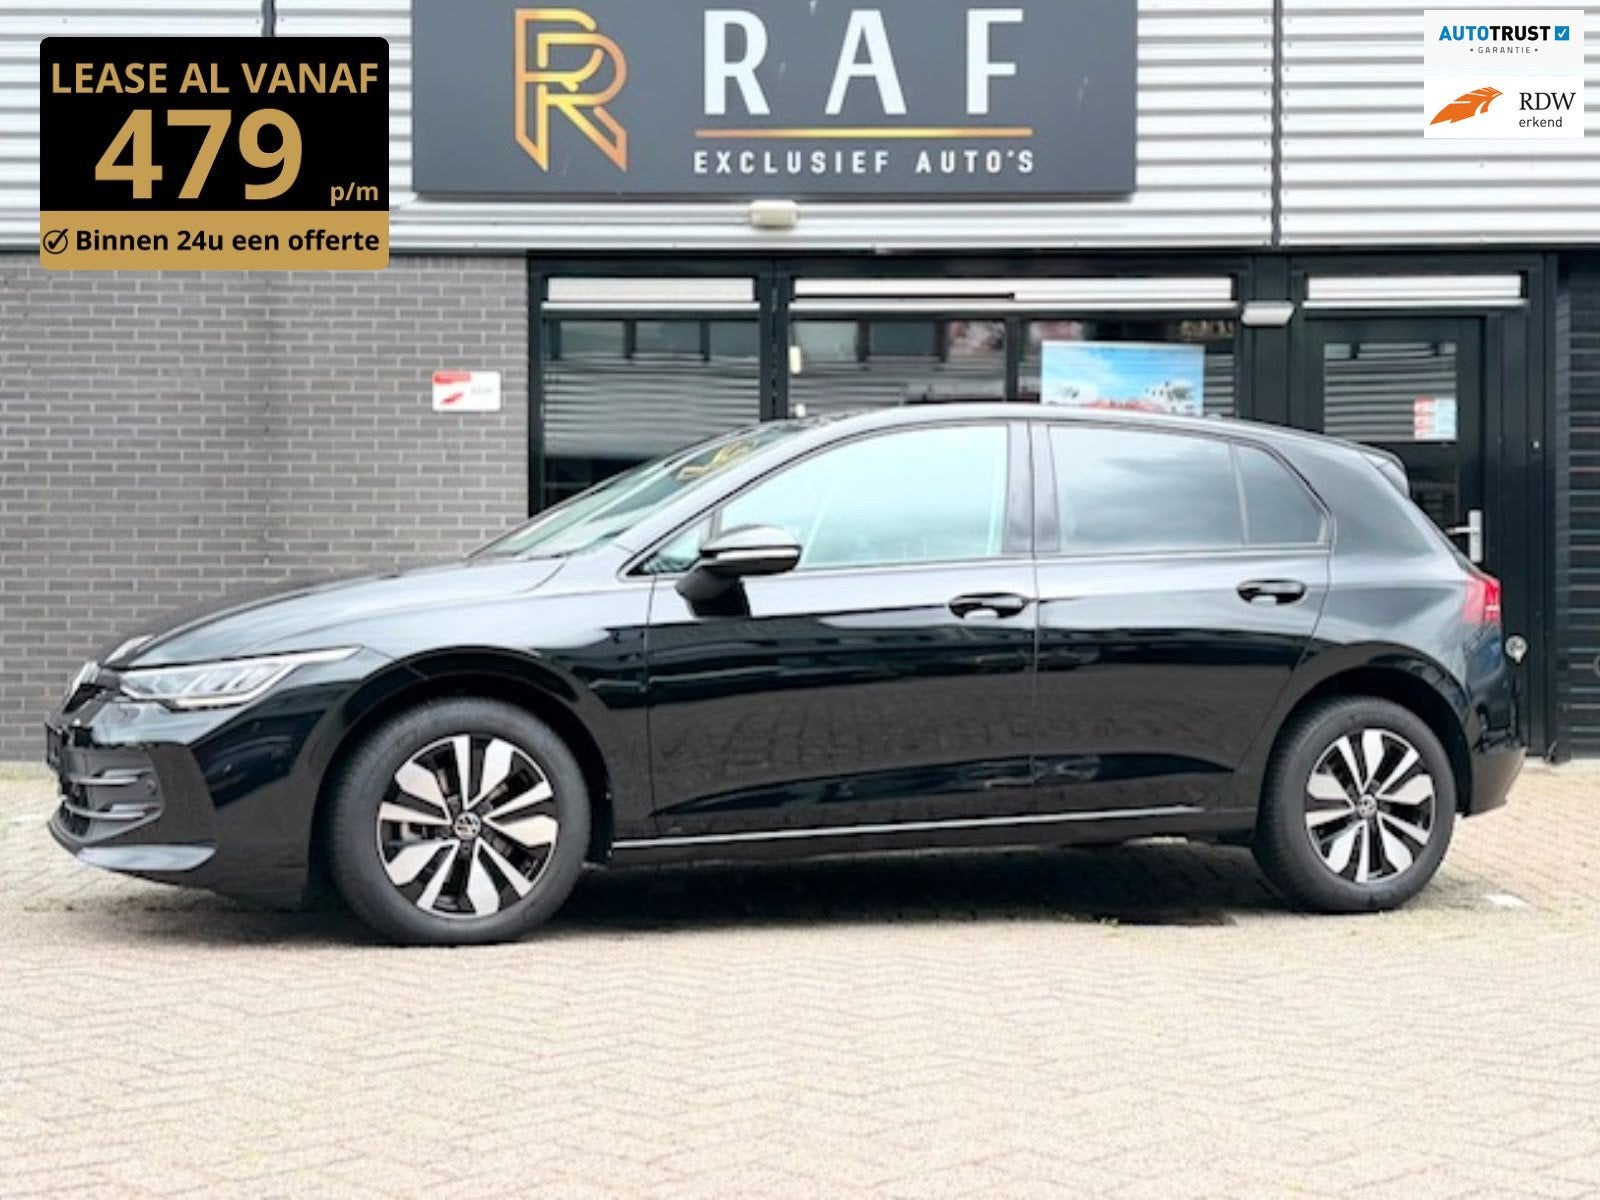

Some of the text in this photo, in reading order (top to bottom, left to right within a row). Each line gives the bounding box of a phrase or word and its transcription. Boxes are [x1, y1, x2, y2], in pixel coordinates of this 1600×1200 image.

[703, 9, 1024, 115] RAF
[694, 150, 1034, 174] EXCLUSIEF AUTO'S
